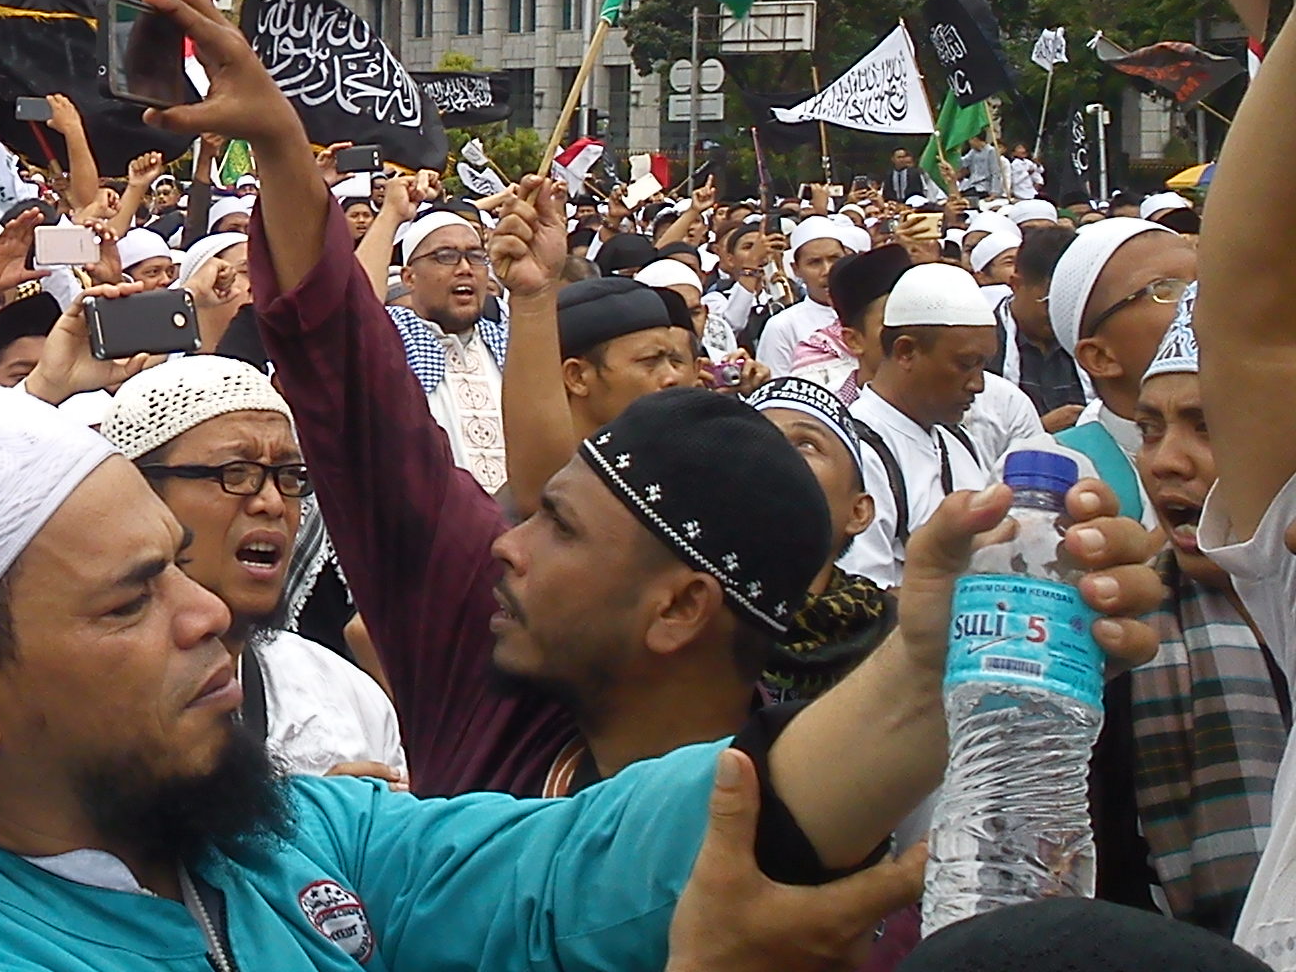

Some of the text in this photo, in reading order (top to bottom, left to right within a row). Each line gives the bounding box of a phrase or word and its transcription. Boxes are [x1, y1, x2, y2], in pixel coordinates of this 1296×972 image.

[782, 379, 842, 415] AHOK
[994, 584, 1027, 595] DALAM
[1029, 588, 1074, 605] KEMASAN
[1025, 615, 1047, 644] 5
